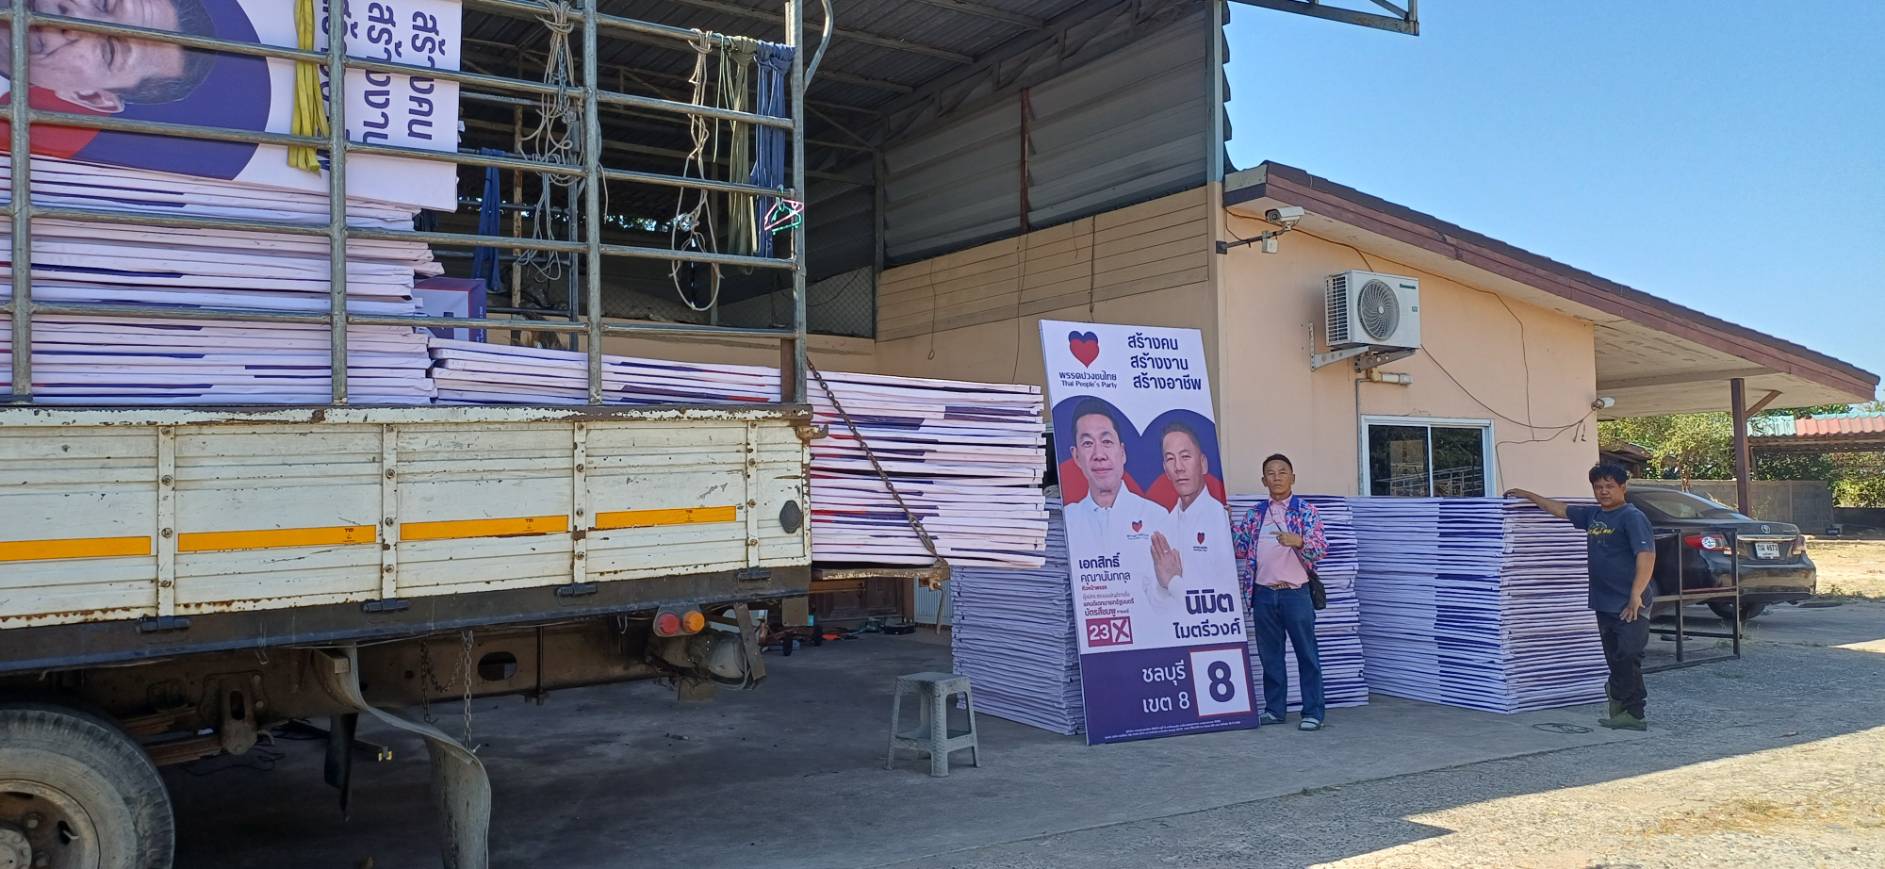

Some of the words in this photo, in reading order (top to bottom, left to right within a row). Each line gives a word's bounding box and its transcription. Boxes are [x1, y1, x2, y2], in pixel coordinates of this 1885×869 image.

[1127, 332, 1179, 351] สร้างคน
[1130, 352, 1189, 370] สร้างงาน
[1133, 372, 1202, 391] สร้างอาชีพ
[1184, 588, 1236, 615] นิมิต
[1088, 624, 1111, 641] 23
[1172, 617, 1241, 639] ไมตรีวงศ์
[1141, 659, 1187, 686] ชลบุรี
[1207, 660, 1236, 703] 8
[1142, 698, 1173, 713] เขต
[1178, 691, 1191, 710] 8
